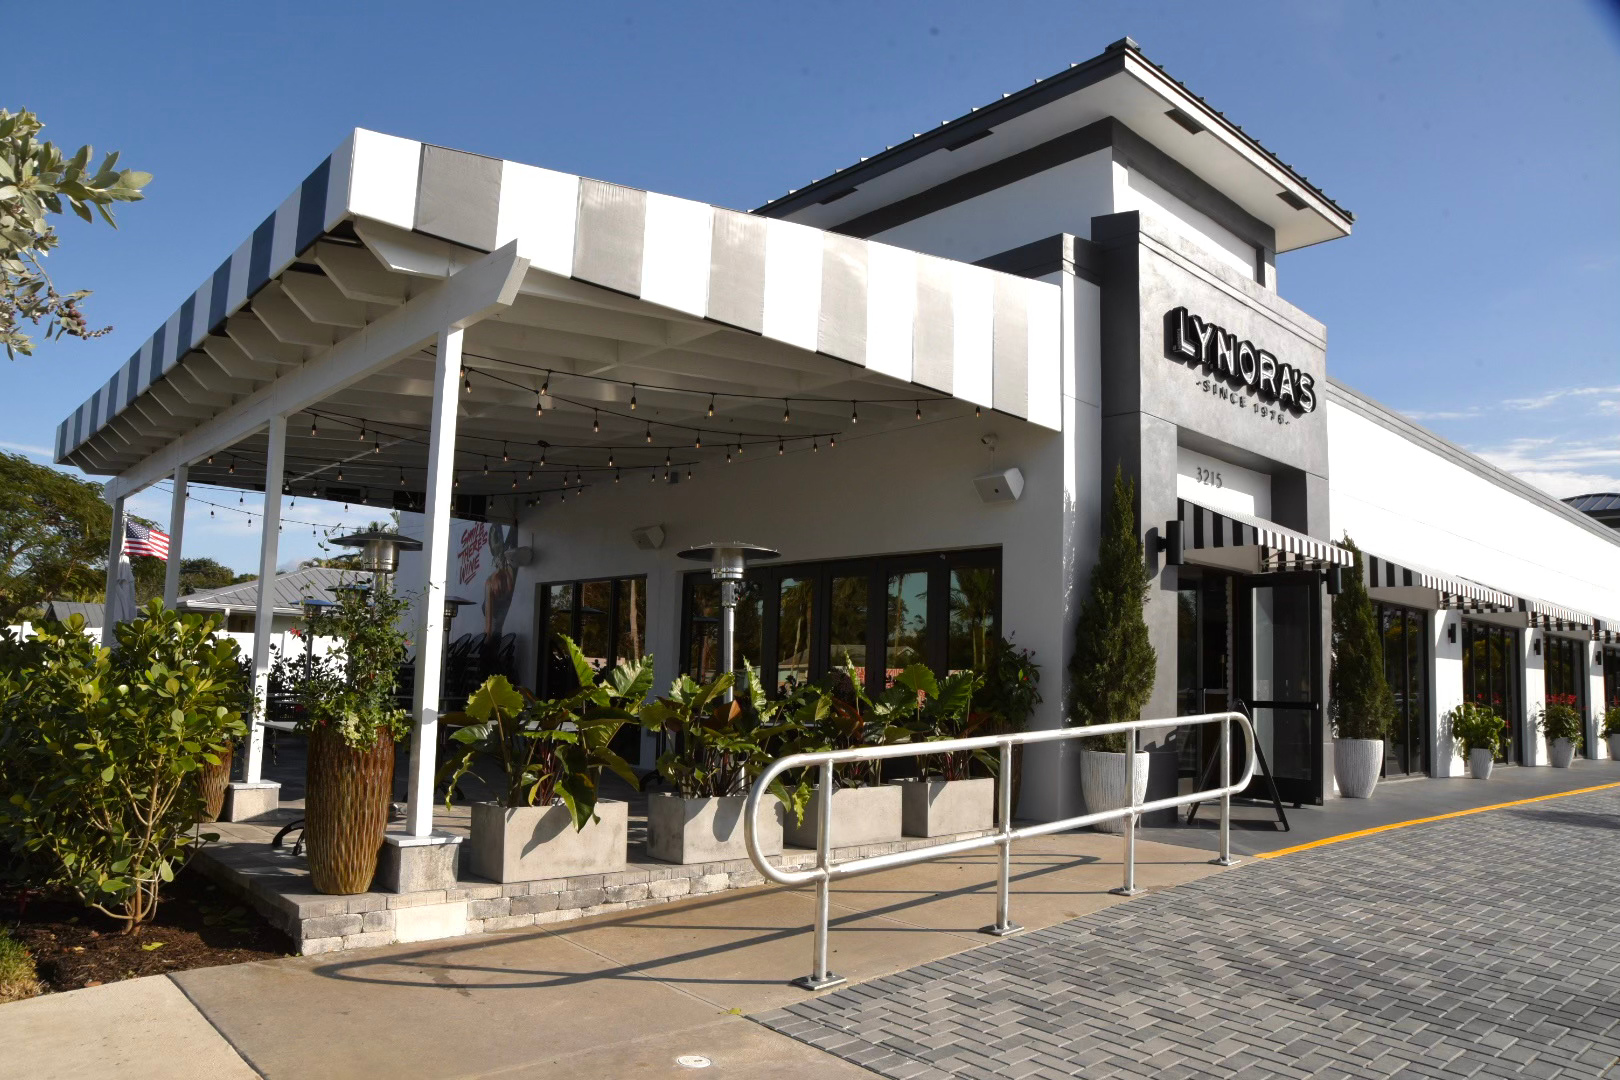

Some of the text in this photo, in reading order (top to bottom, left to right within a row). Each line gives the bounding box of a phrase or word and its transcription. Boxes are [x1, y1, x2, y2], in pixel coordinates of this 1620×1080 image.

[1170, 306, 1317, 414] LYNORA'S
[1196, 467, 1222, 488] 3215
[459, 553, 480, 584] WINE
